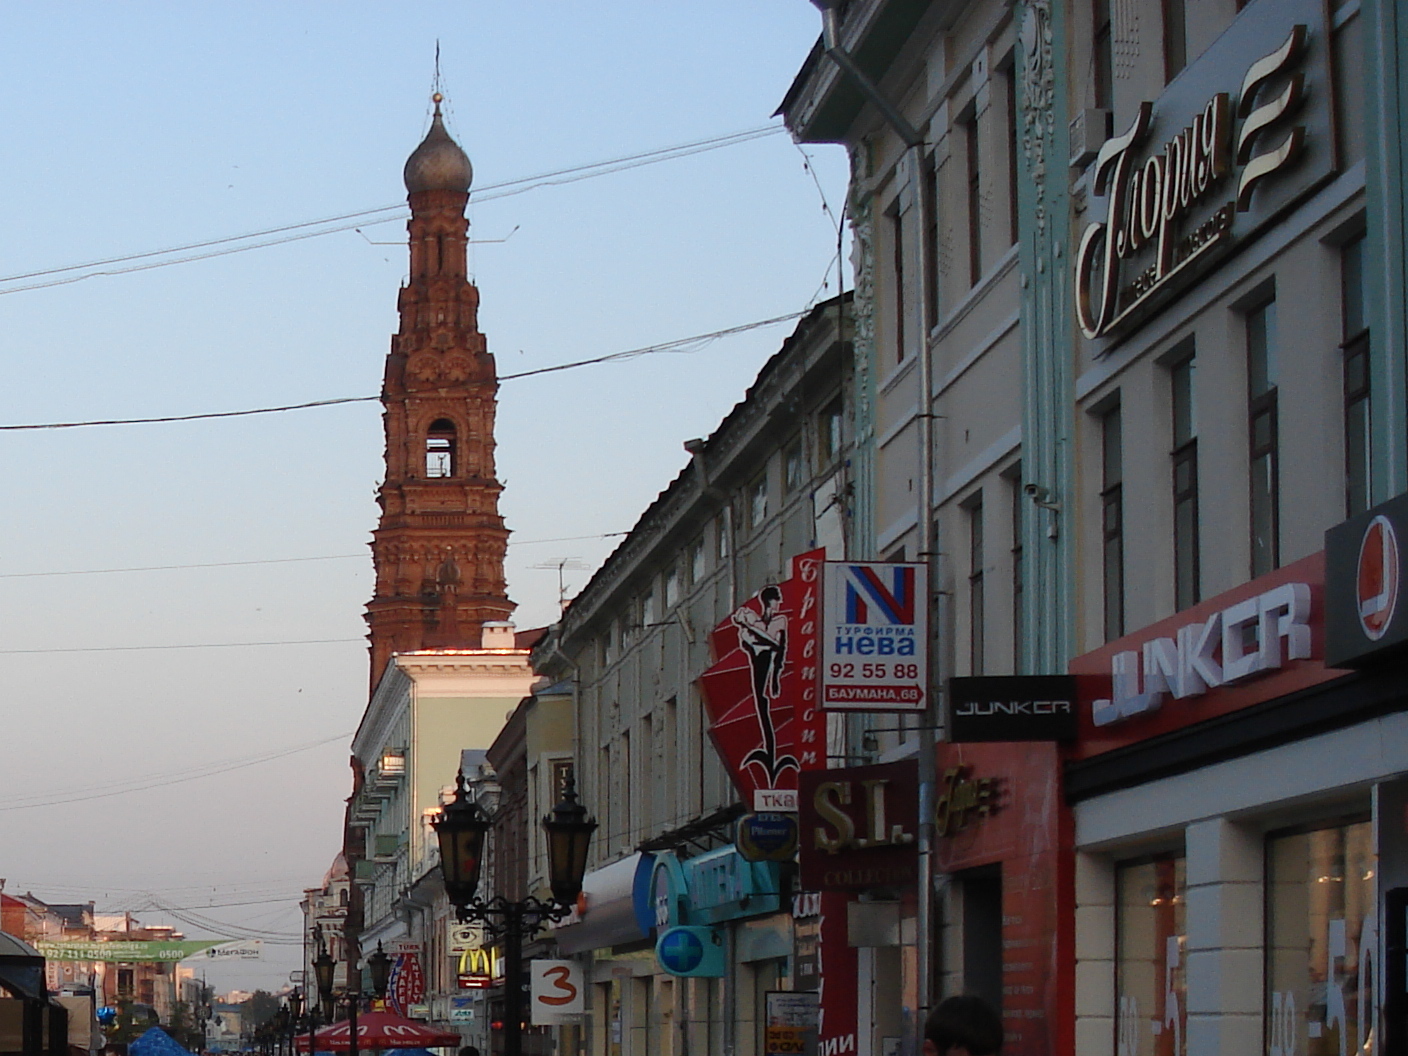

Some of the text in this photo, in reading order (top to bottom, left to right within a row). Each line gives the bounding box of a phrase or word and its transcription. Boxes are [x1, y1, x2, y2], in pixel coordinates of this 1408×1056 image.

[836, 626, 915, 636] ТУРФИРМА
[1092, 583, 1312, 727] JUNKER
[830, 664, 918, 679] 92 55 88
[956, 700, 1071, 717] JUNKER
[159, 950, 184, 959] 0500
